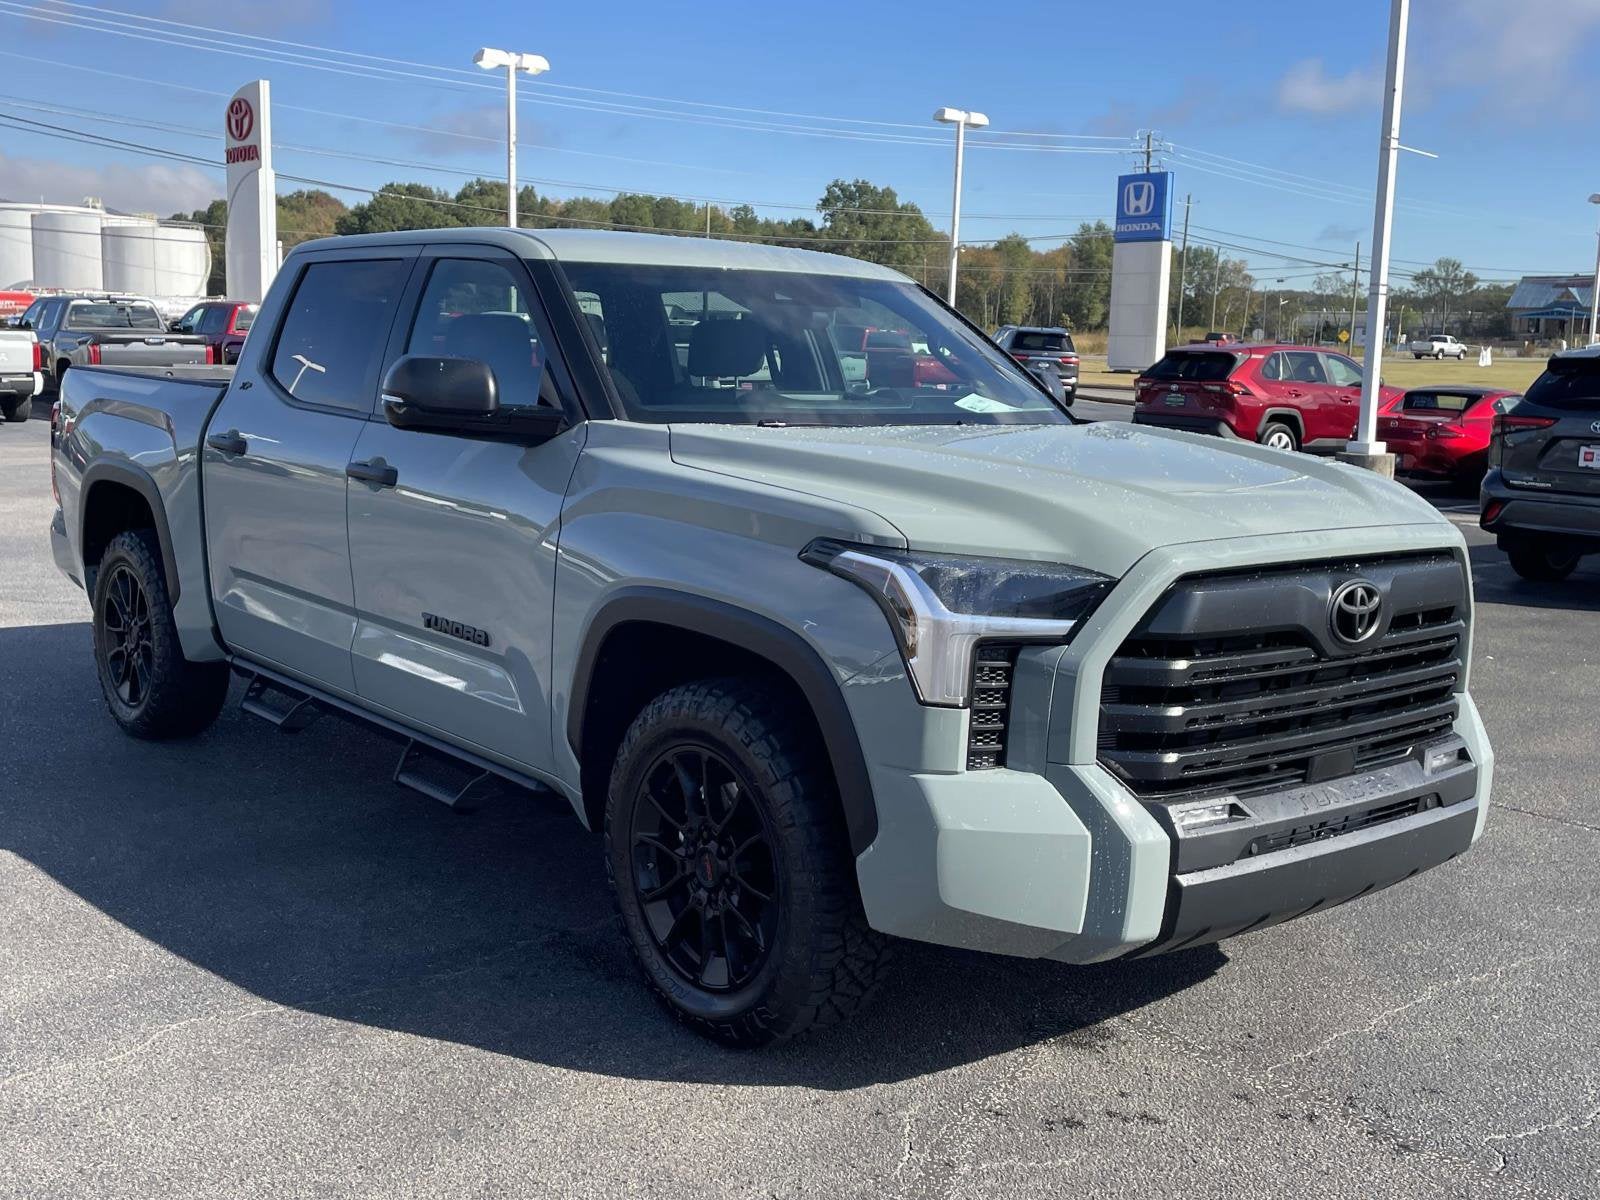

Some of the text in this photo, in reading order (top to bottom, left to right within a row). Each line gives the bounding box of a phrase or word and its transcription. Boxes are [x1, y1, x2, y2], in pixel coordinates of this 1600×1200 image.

[225, 145, 259, 164] TOYOTA
[1116, 222, 1161, 232] HONDA
[421, 612, 490, 647] TUNDRA
